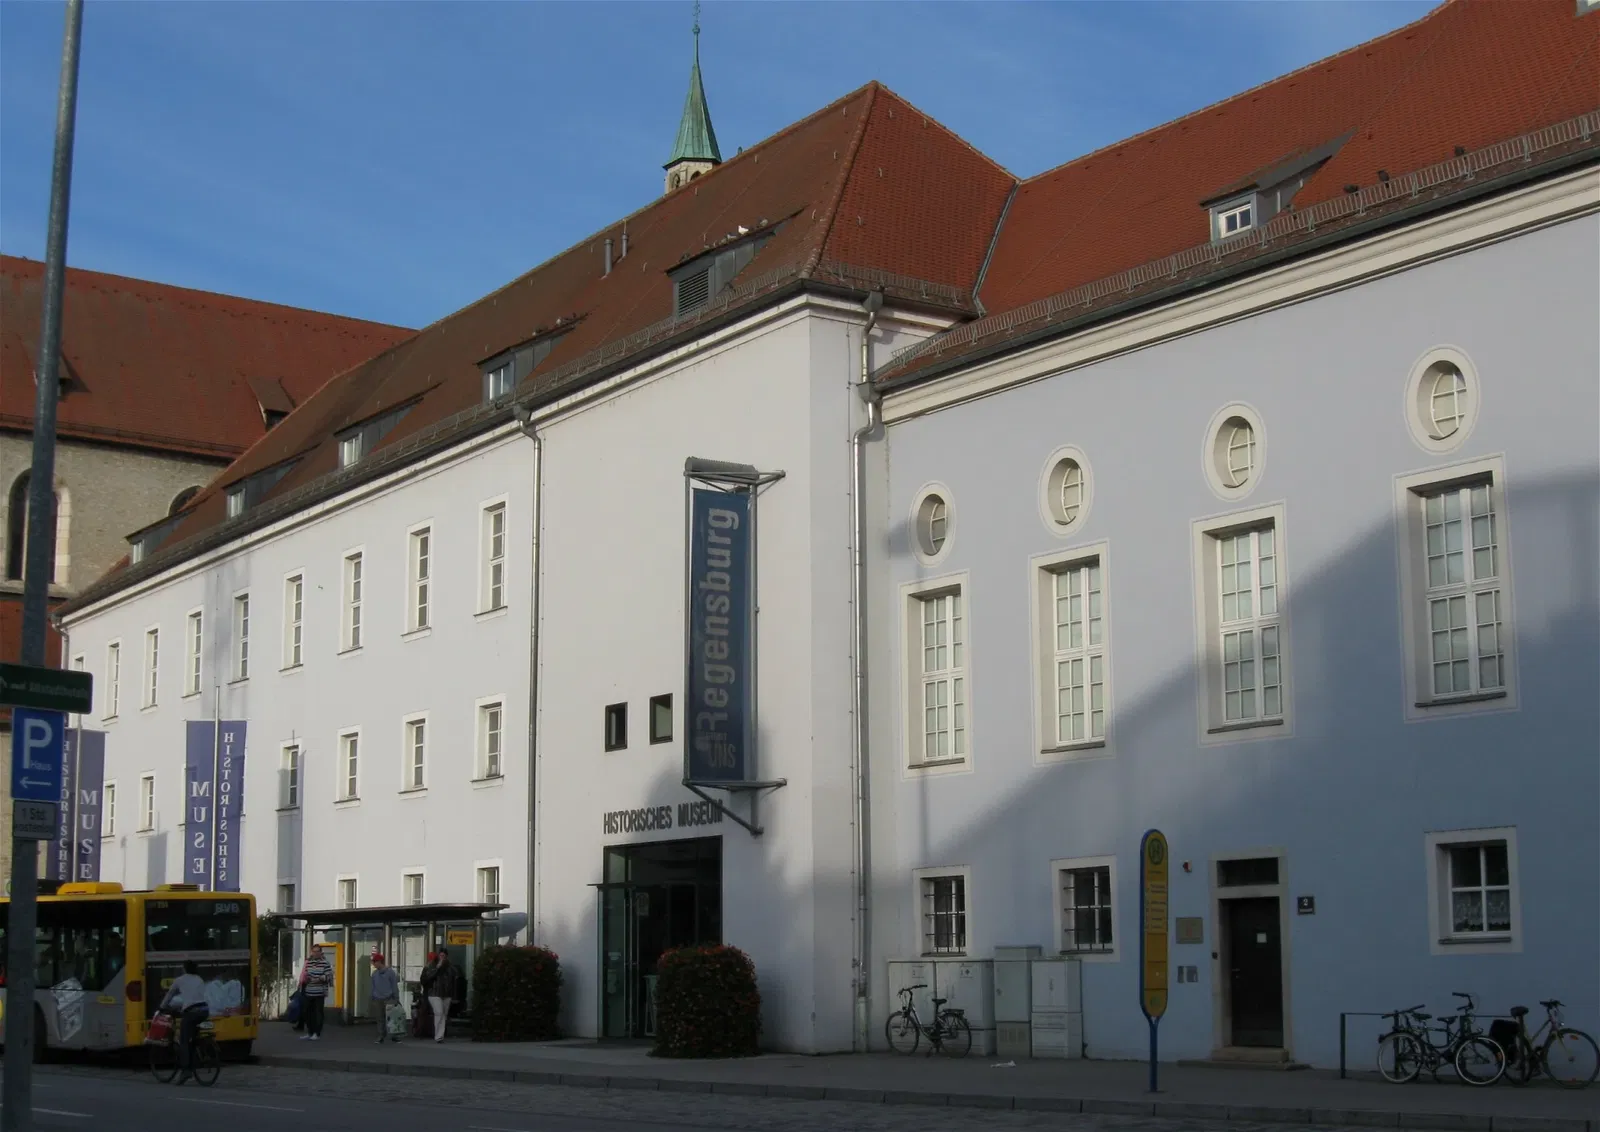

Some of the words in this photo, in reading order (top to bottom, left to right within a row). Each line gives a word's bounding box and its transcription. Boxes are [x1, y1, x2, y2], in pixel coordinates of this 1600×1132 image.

[695, 507, 738, 731] Regensburg
[22, 718, 53, 770] P
[603, 805, 673, 834] HISTORISCHES
[678, 799, 723, 827] MUSEUM
[1303, 898, 1309, 907] 2
